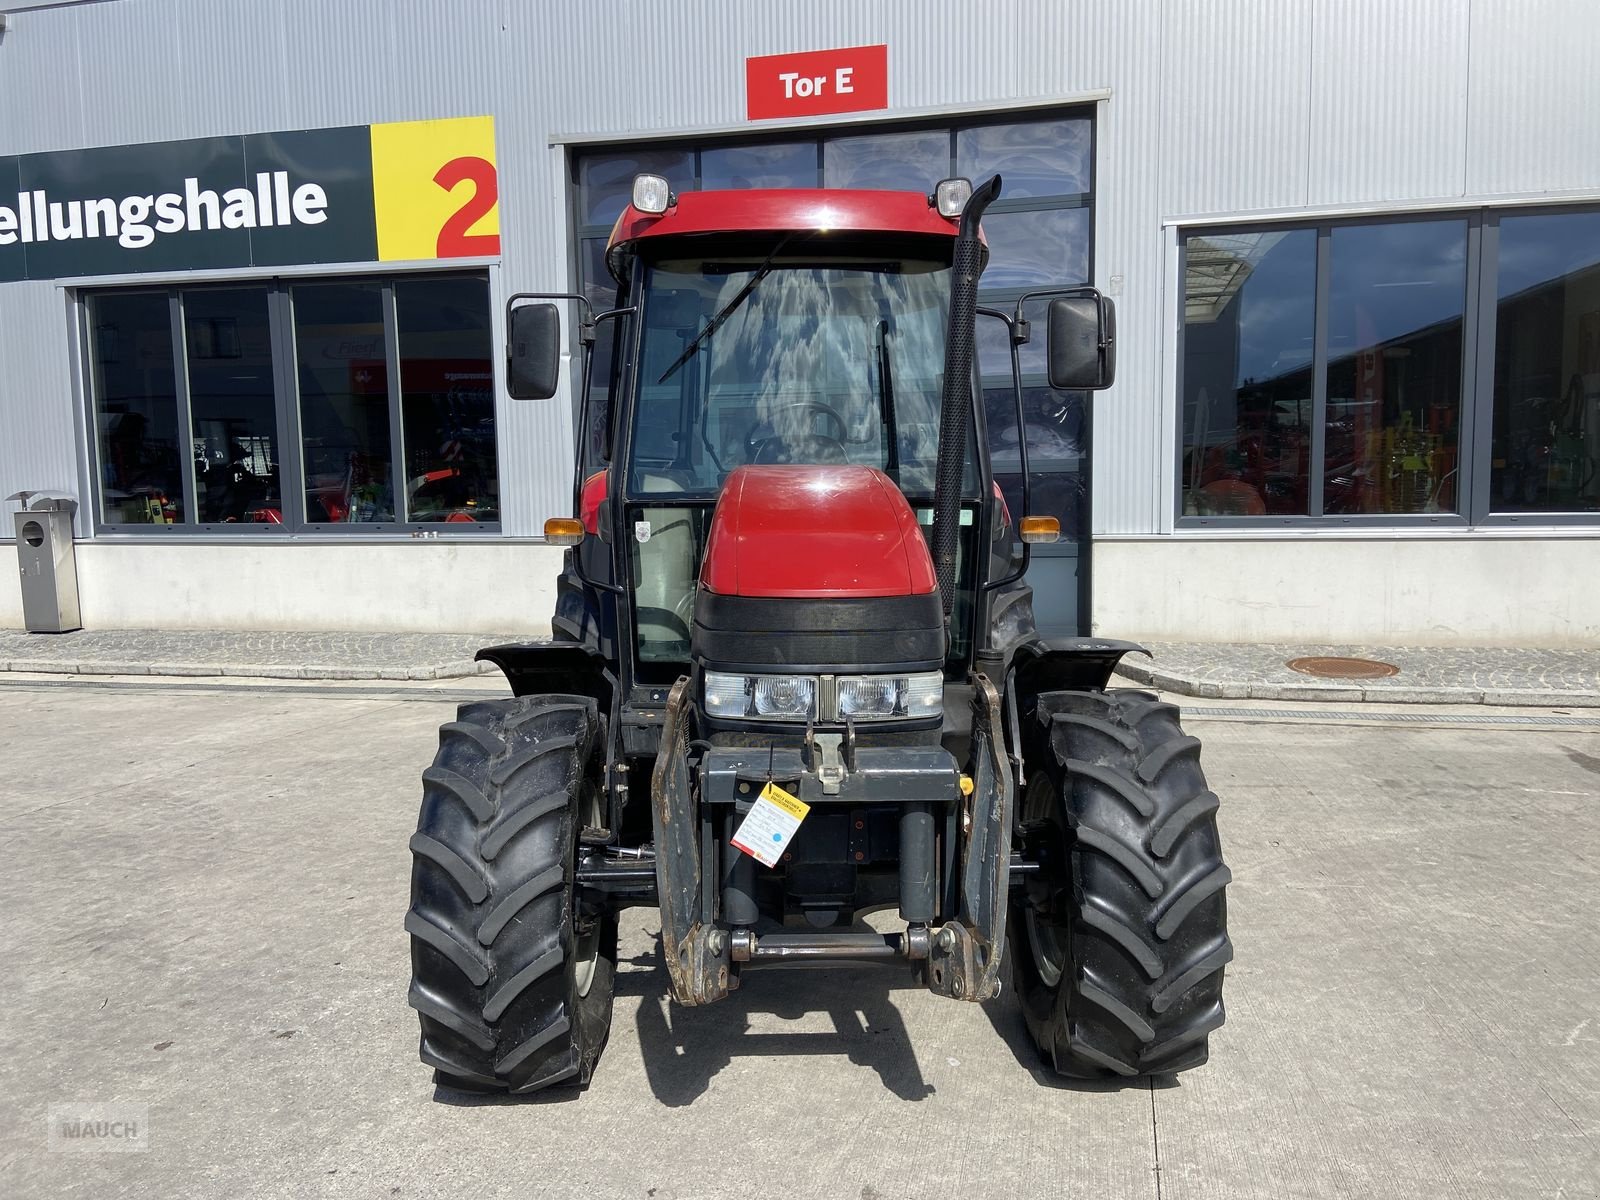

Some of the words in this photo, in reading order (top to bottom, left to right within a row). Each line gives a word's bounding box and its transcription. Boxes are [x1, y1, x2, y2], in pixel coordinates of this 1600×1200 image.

[779, 72, 827, 98] Tor
[836, 67, 854, 94] E
[0, 171, 328, 249] ellungshalle
[433, 156, 501, 259] 2
